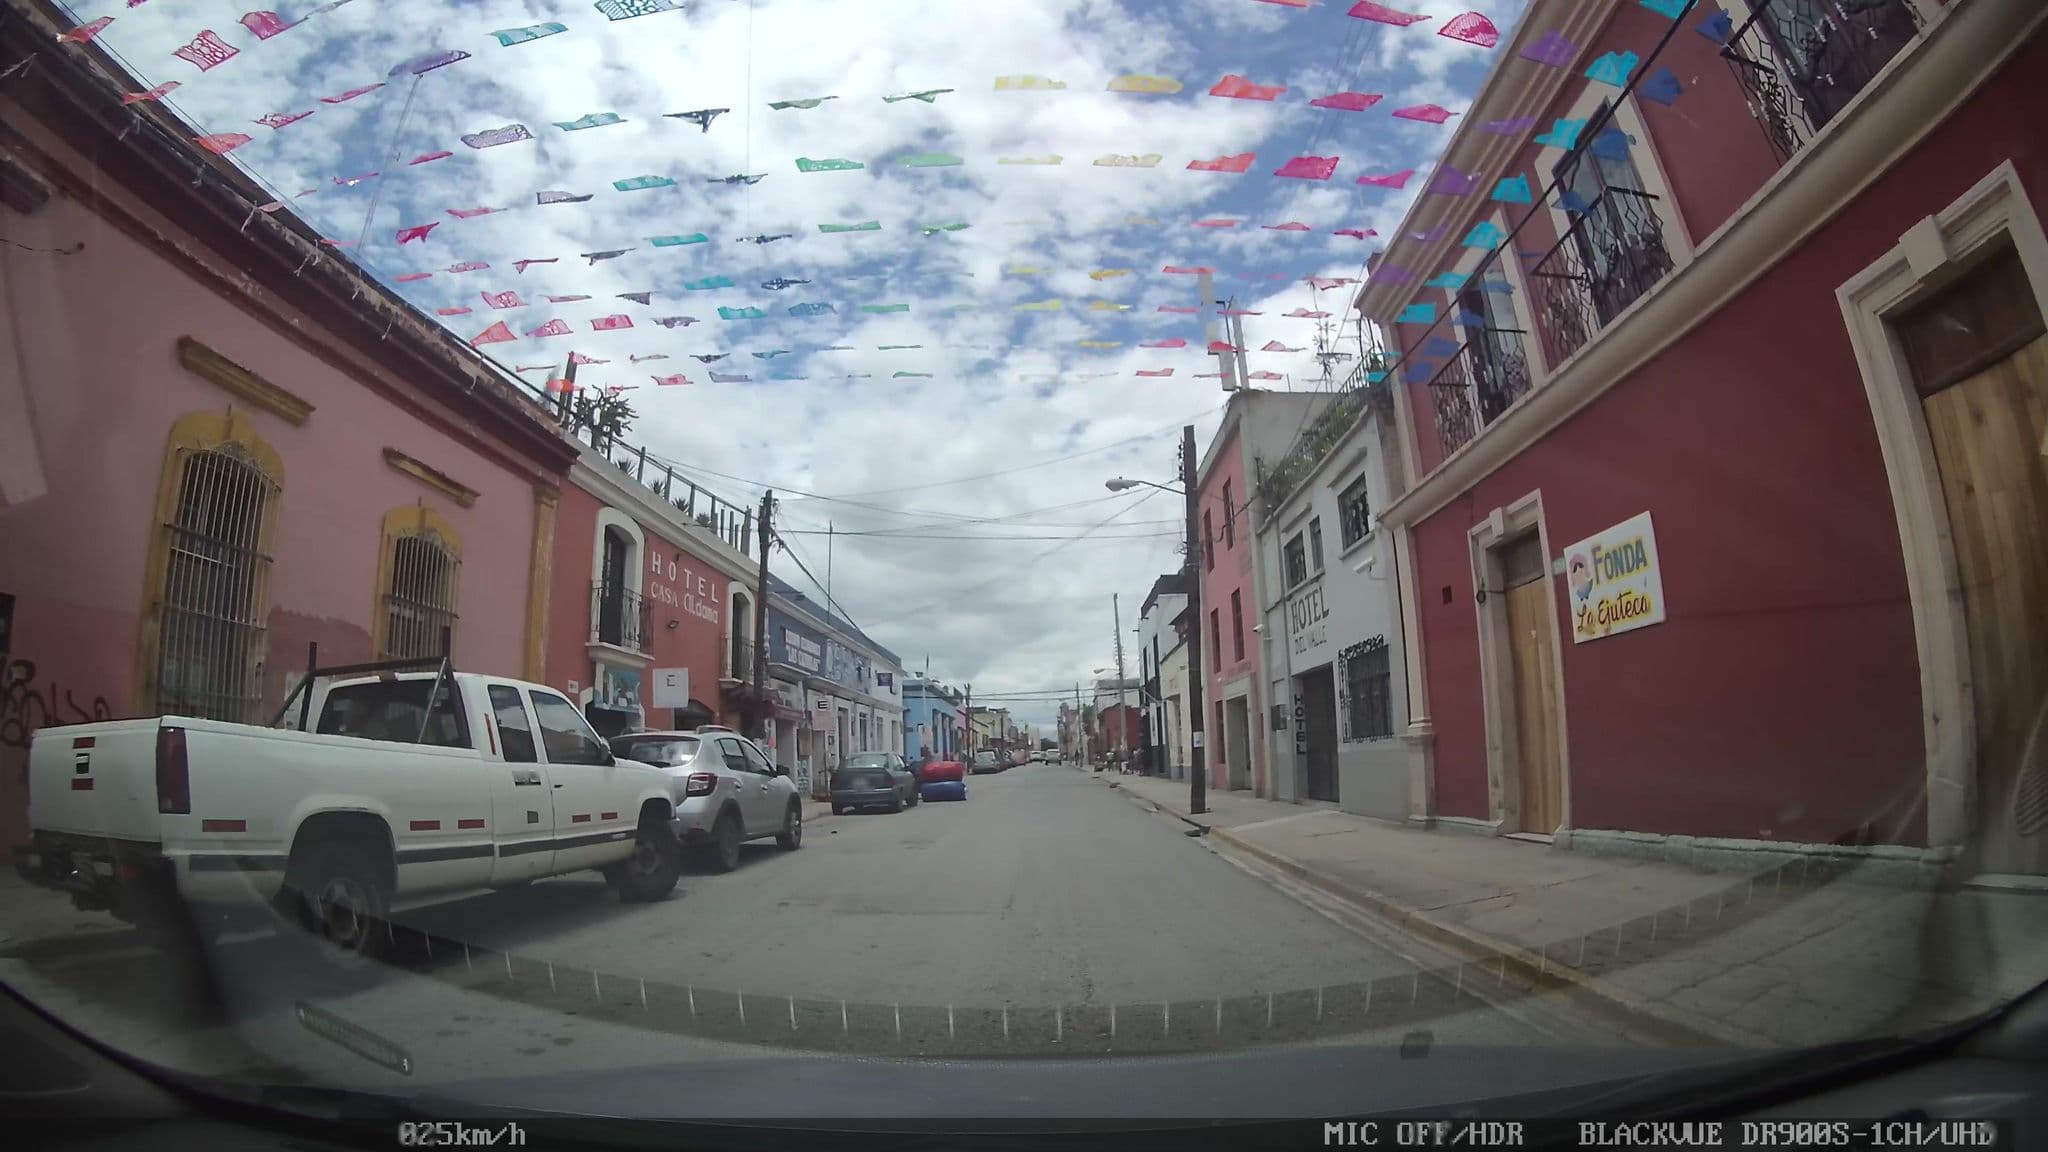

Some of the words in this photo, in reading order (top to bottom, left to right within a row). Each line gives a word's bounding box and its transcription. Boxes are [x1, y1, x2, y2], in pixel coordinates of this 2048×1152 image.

[652, 551, 719, 603] HOTEL
[1591, 538, 1648, 585] FONDA
[1291, 586, 1330, 635] HOTEL
[1577, 603, 1595, 632] La
[1294, 693, 1307, 755] HOTEL
